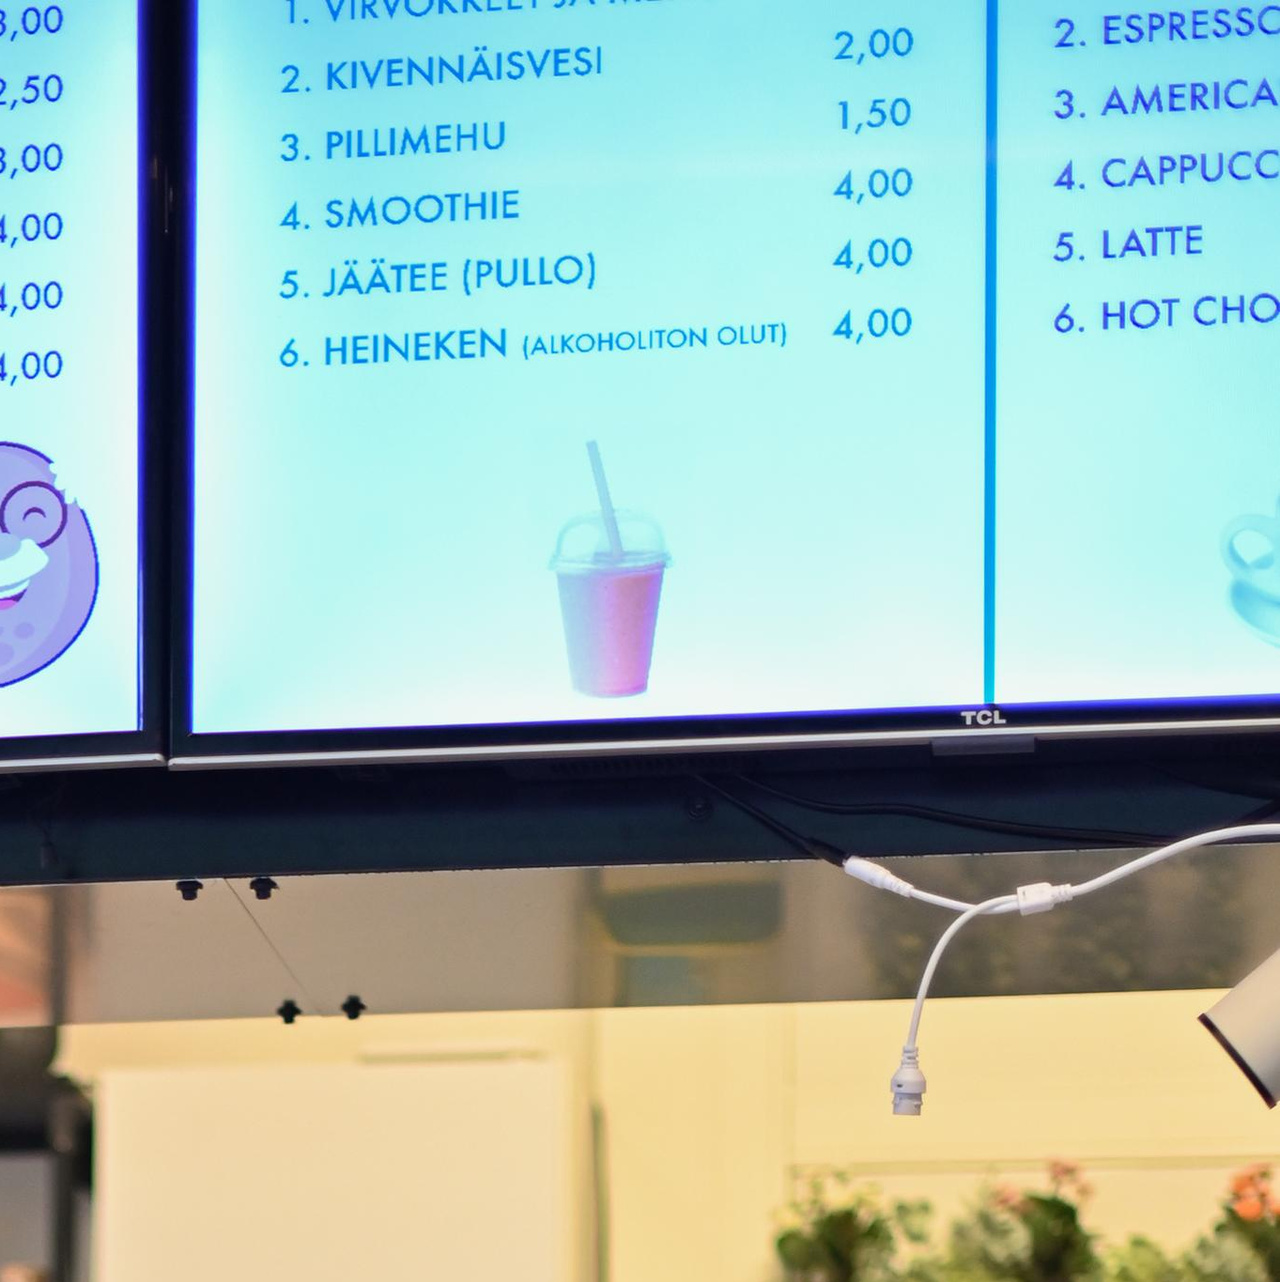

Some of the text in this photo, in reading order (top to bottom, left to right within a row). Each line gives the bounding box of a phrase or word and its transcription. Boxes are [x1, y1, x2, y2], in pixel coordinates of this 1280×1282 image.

[832, 27, 914, 66] 2,00
[1048, 15, 1087, 51] 2.
[281, 45, 603, 93] 2. KIVENNÄISVESI
[838, 97, 914, 135] 1,50
[1049, 89, 1086, 121] 3.
[280, 120, 507, 162] 3. PILLIMEHU
[832, 166, 915, 207] 4,00
[1050, 159, 1086, 193] 4.
[278, 189, 523, 232] 4. SMOOTHIE
[832, 235, 915, 277] 4,00
[1053, 224, 1203, 264] 5. LATTE
[278, 250, 597, 301] 5. JÄÄTEE (PULLO)
[831, 306, 914, 346] 4,00
[1054, 302, 1085, 336] 6.
[1099, 298, 1182, 332] HOT
[277, 320, 789, 369] 6. HEINEKEN (ALKOHOLITON OLUT)
[960, 710, 1007, 725] TCL
